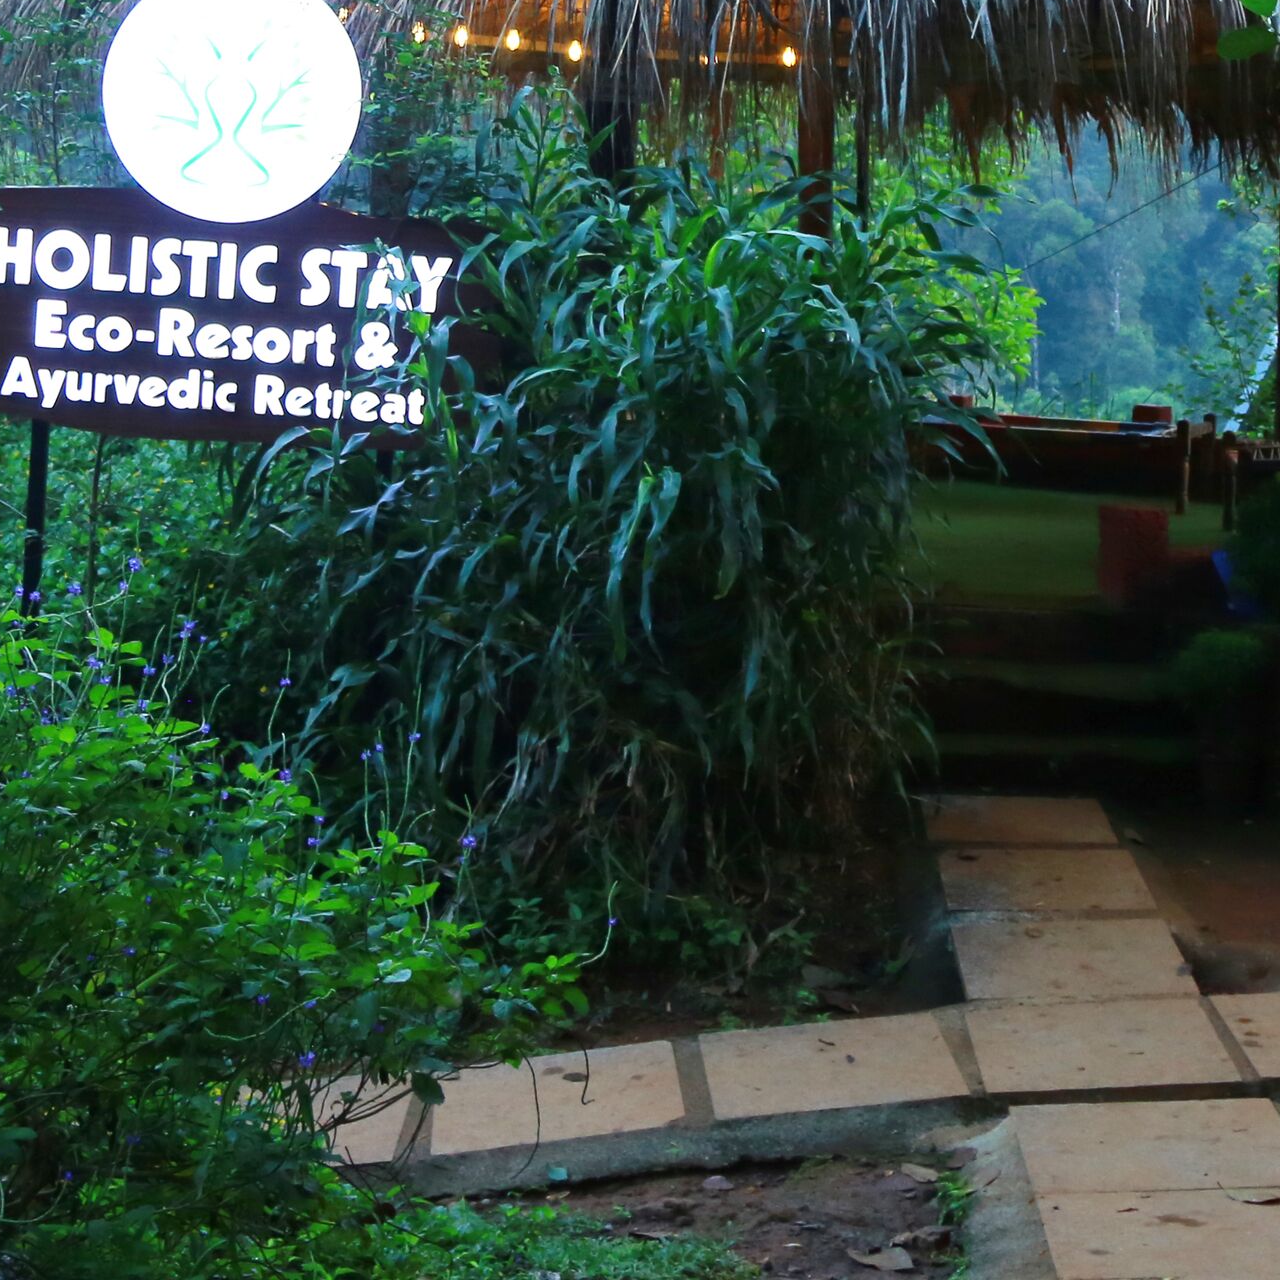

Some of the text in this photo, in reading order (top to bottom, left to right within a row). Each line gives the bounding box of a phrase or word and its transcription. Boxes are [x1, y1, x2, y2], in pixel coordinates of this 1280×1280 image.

[299, 247, 454, 313] STAY
[33, 298, 399, 371] Eco-Resort &
[0, 355, 425, 425] Ayurvedic Retreat
